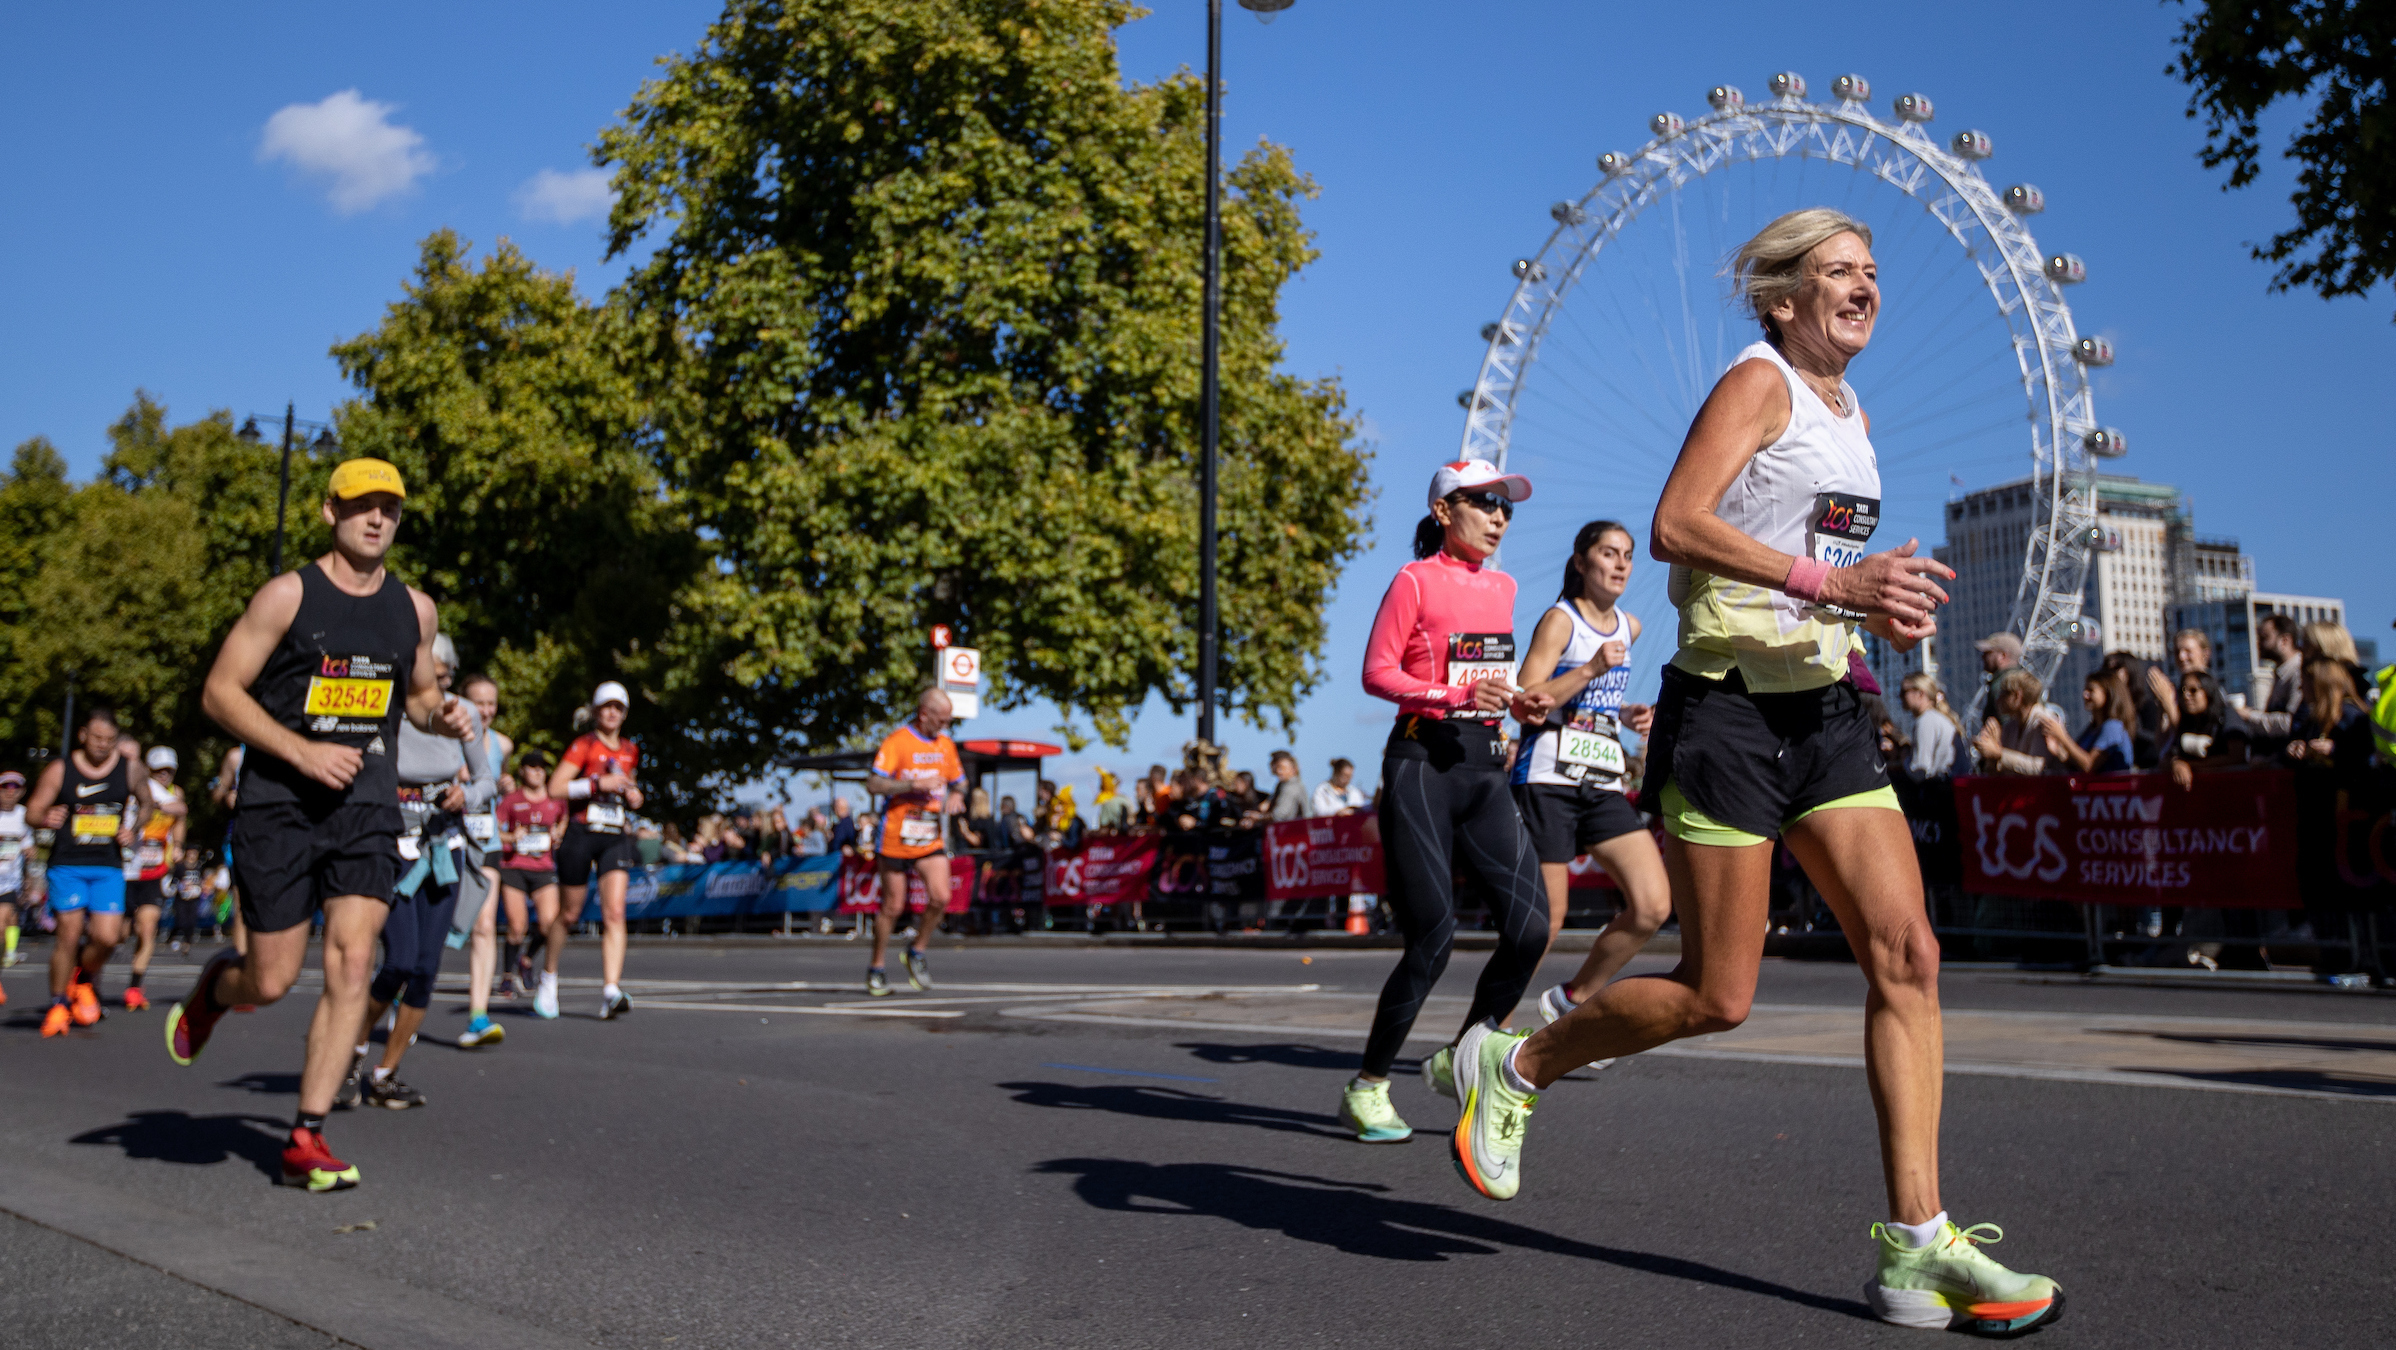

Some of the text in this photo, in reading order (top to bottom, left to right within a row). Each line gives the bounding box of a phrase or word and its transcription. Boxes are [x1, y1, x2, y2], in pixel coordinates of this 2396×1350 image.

[1822, 499, 1853, 531] tcs
[1856, 503, 1869, 515] TATA
[934, 626, 949, 647] K
[1456, 637, 1482, 659] tcs
[321, 654, 349, 677] tcs
[319, 685, 382, 710] 32542
[1569, 737, 1618, 764] 28544
[2072, 795, 2150, 822] TATA
[1972, 794, 2068, 882] tcs
[2076, 826, 2265, 854] CONSULTANCY
[2079, 860, 2191, 887] SERVICES
